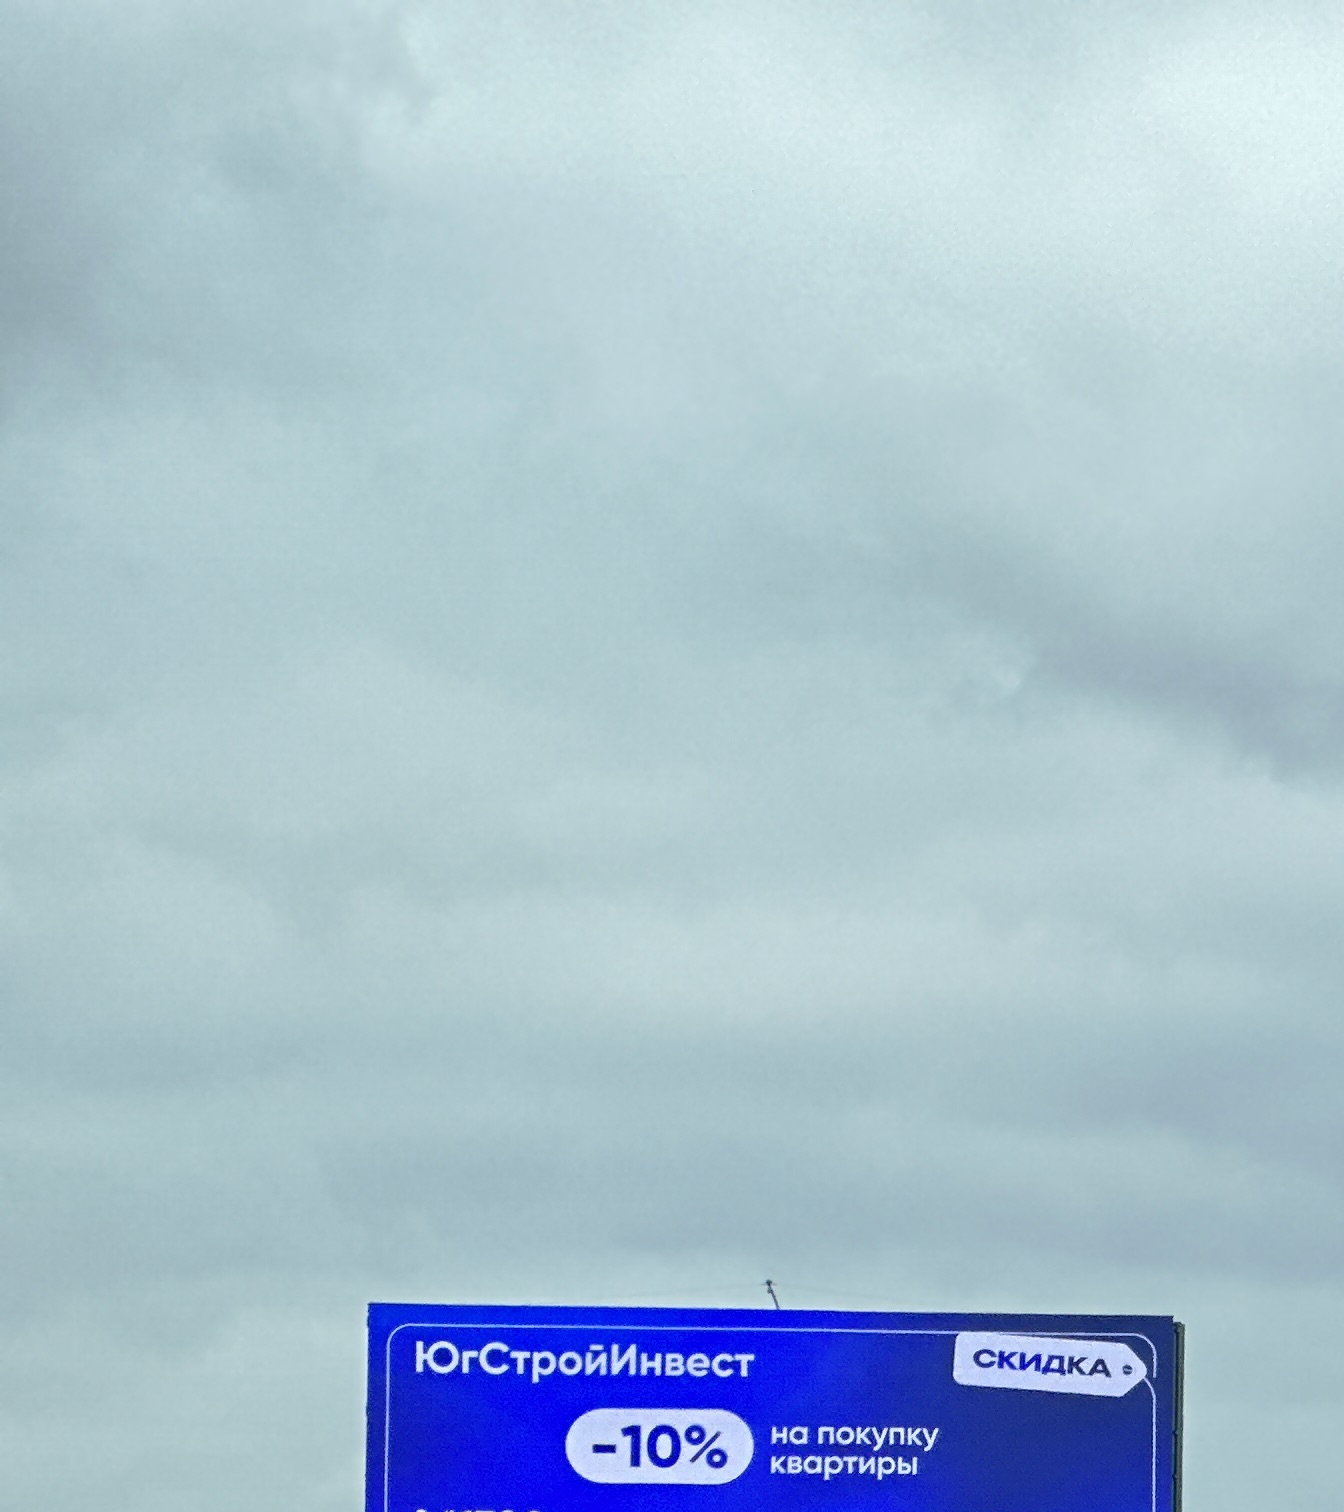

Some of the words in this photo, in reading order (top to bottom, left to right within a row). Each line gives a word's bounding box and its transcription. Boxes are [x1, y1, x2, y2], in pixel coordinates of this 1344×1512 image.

[415, 1340, 755, 1384] ЮгСтройИнвест
[972, 1348, 1112, 1378] СКИДКА
[592, 1425, 729, 1470] -10%
[771, 1426, 810, 1446] на
[817, 1426, 940, 1451] покупку
[770, 1454, 919, 1480] квартиры
